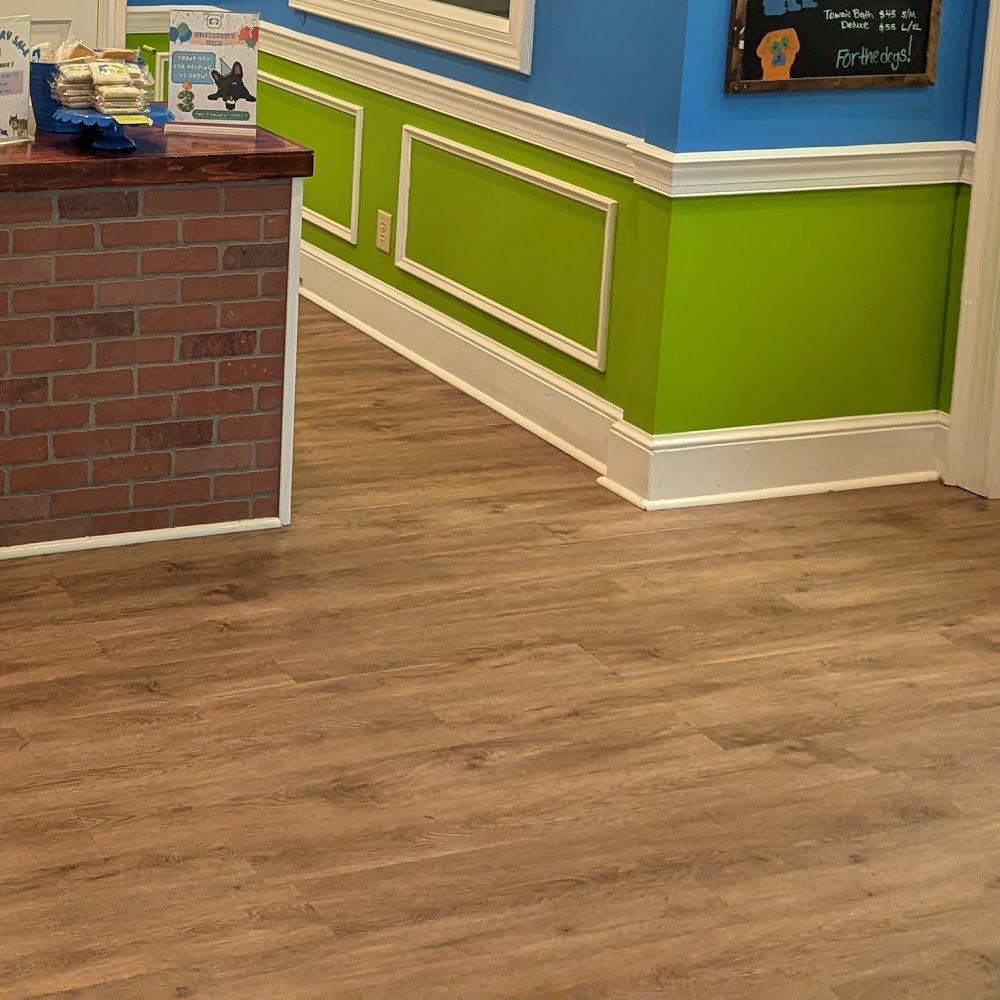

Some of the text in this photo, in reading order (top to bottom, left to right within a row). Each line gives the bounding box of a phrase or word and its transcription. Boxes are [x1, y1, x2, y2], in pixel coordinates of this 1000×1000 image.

[852, 8, 875, 19] Bath
[879, 9, 897, 20] $45
[901, 8, 917, 19] S/M
[840, 20, 870, 30] Deluxe
[12, 36, 30, 57] SALE
[835, 49, 860, 69] For
[858, 46, 880, 65] the
